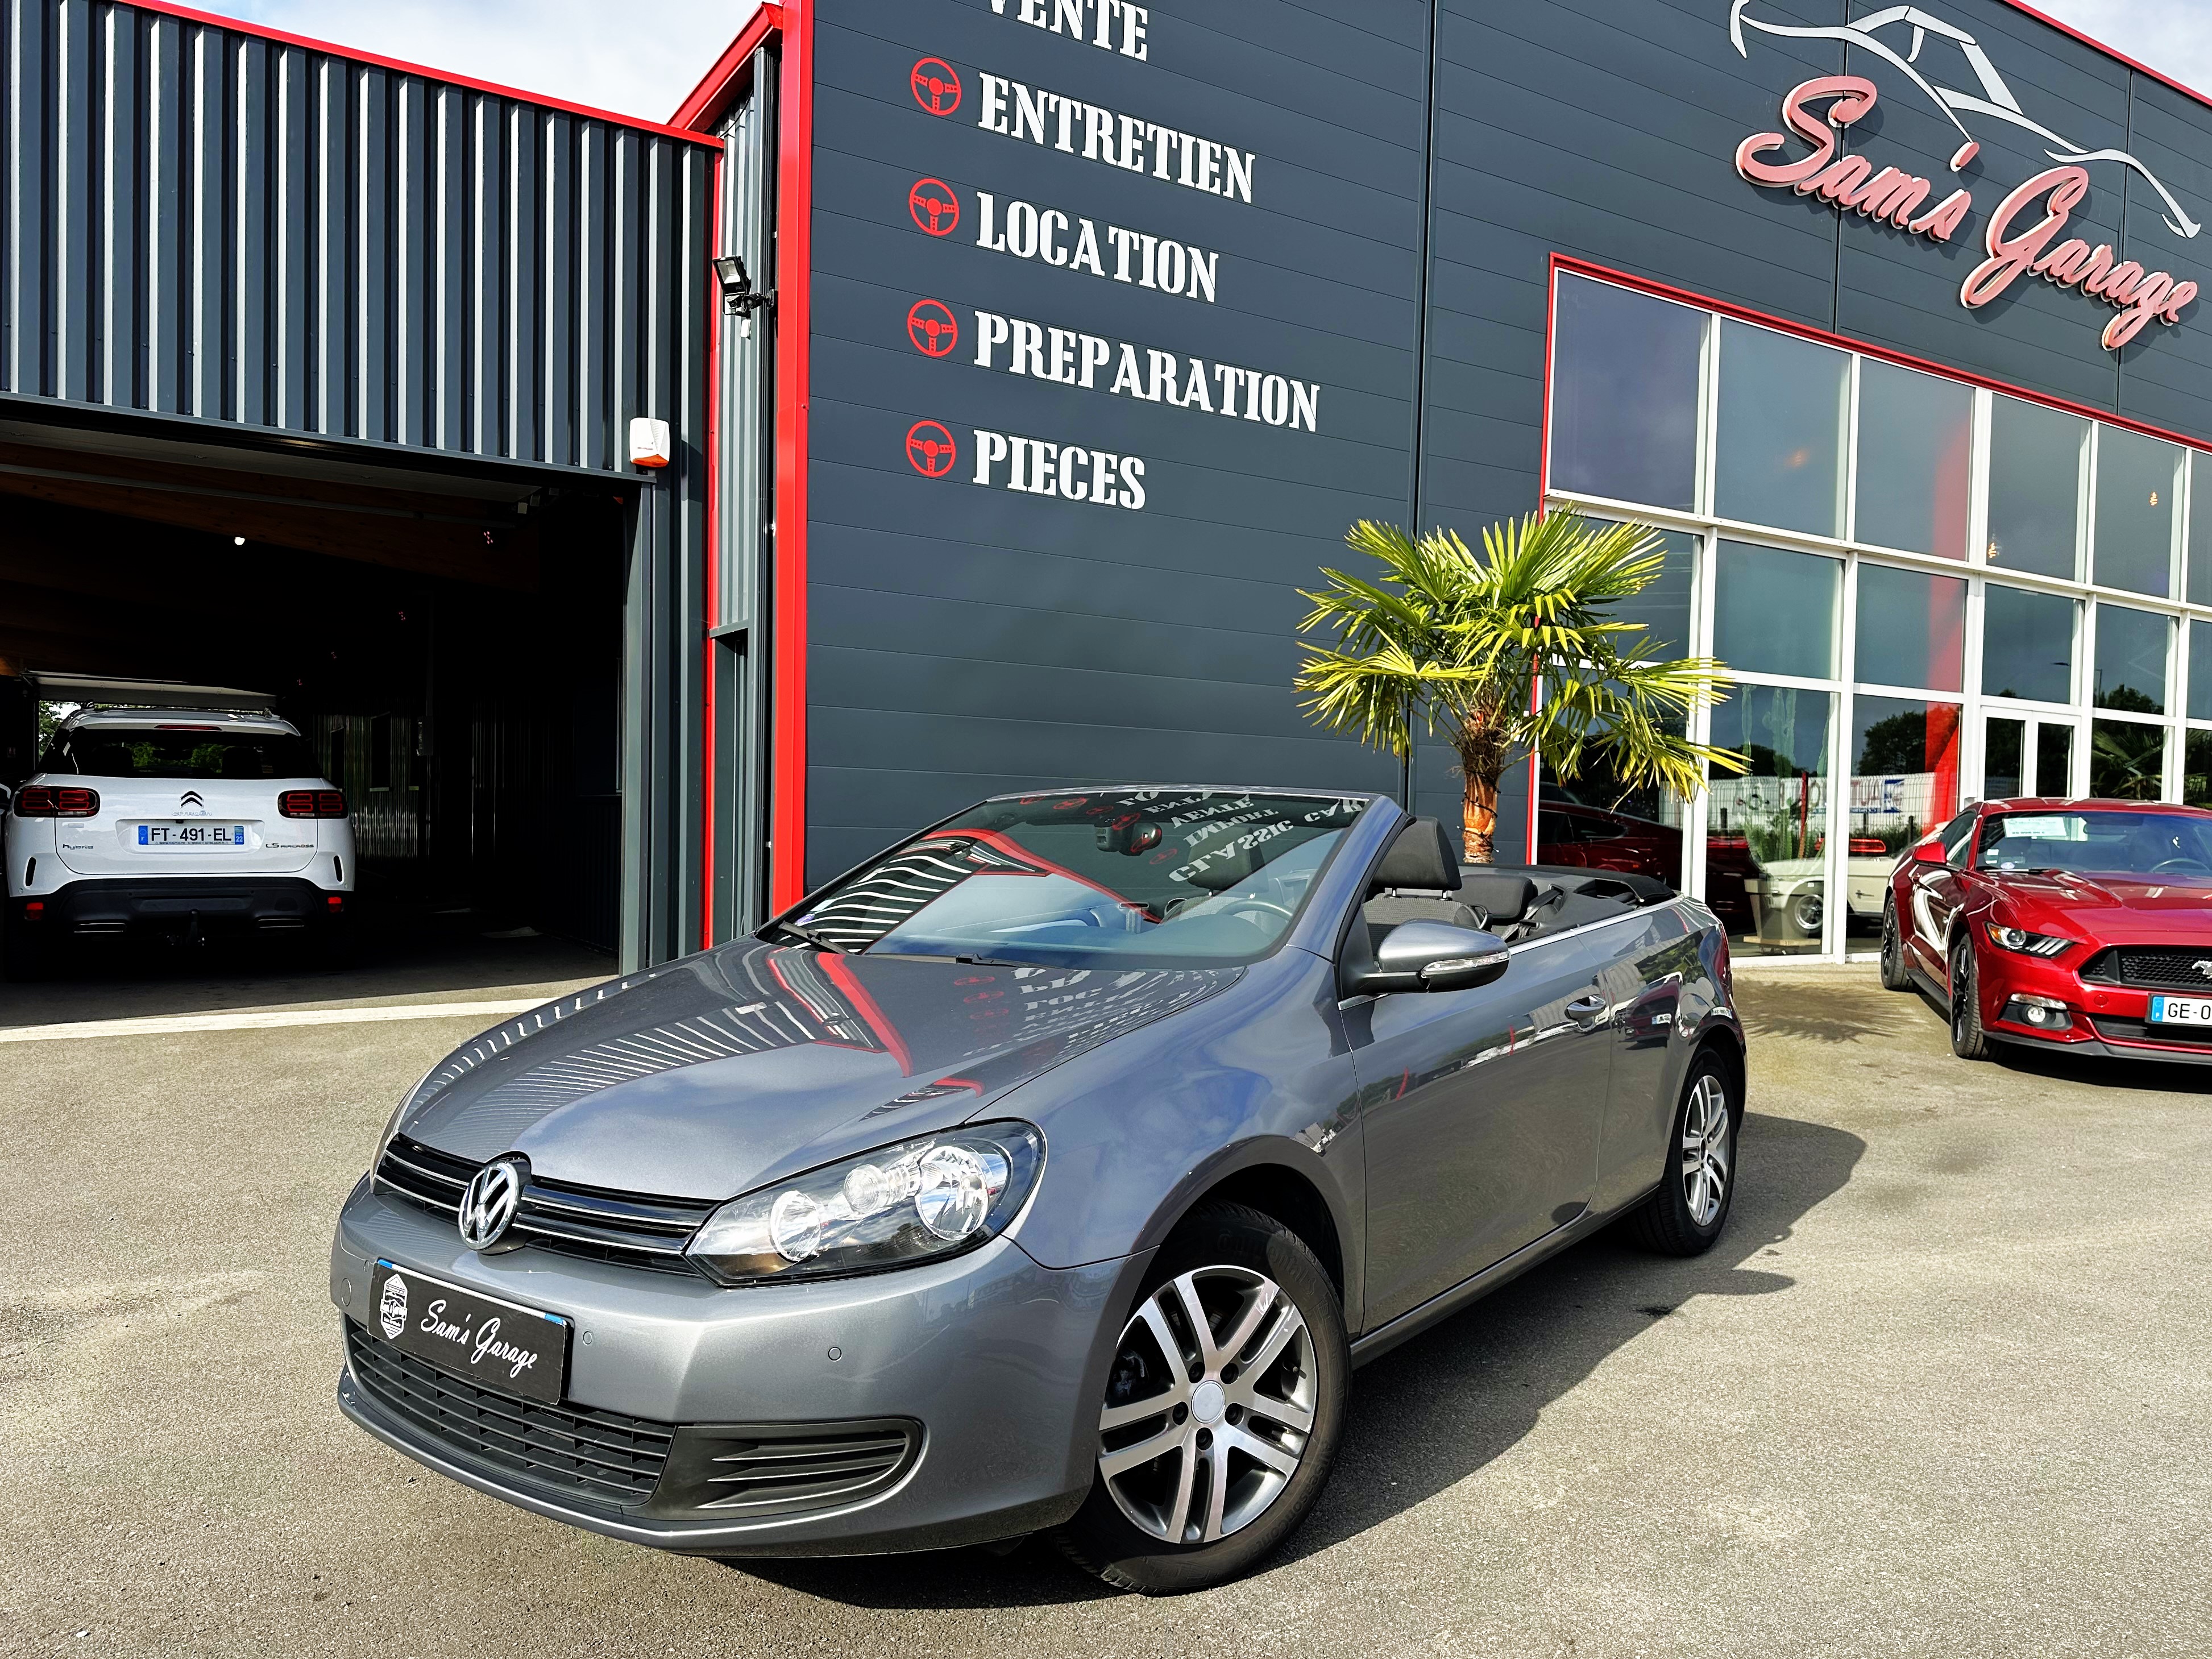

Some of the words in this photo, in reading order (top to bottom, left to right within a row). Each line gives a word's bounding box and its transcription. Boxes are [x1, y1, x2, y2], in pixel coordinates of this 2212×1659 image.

[990, 0, 1148, 61] NTE
[978, 72, 1255, 203] ENTRETIEN
[977, 192, 1218, 302] LOCATION
[1736, 75, 1979, 242] Sam's
[1960, 165, 2198, 351] Garage
[974, 311, 1319, 432] PREPARATION
[973, 430, 1146, 509] PIECES
[421, 1299, 471, 1345] Sam's
[470, 1317, 538, 1378] Garage
